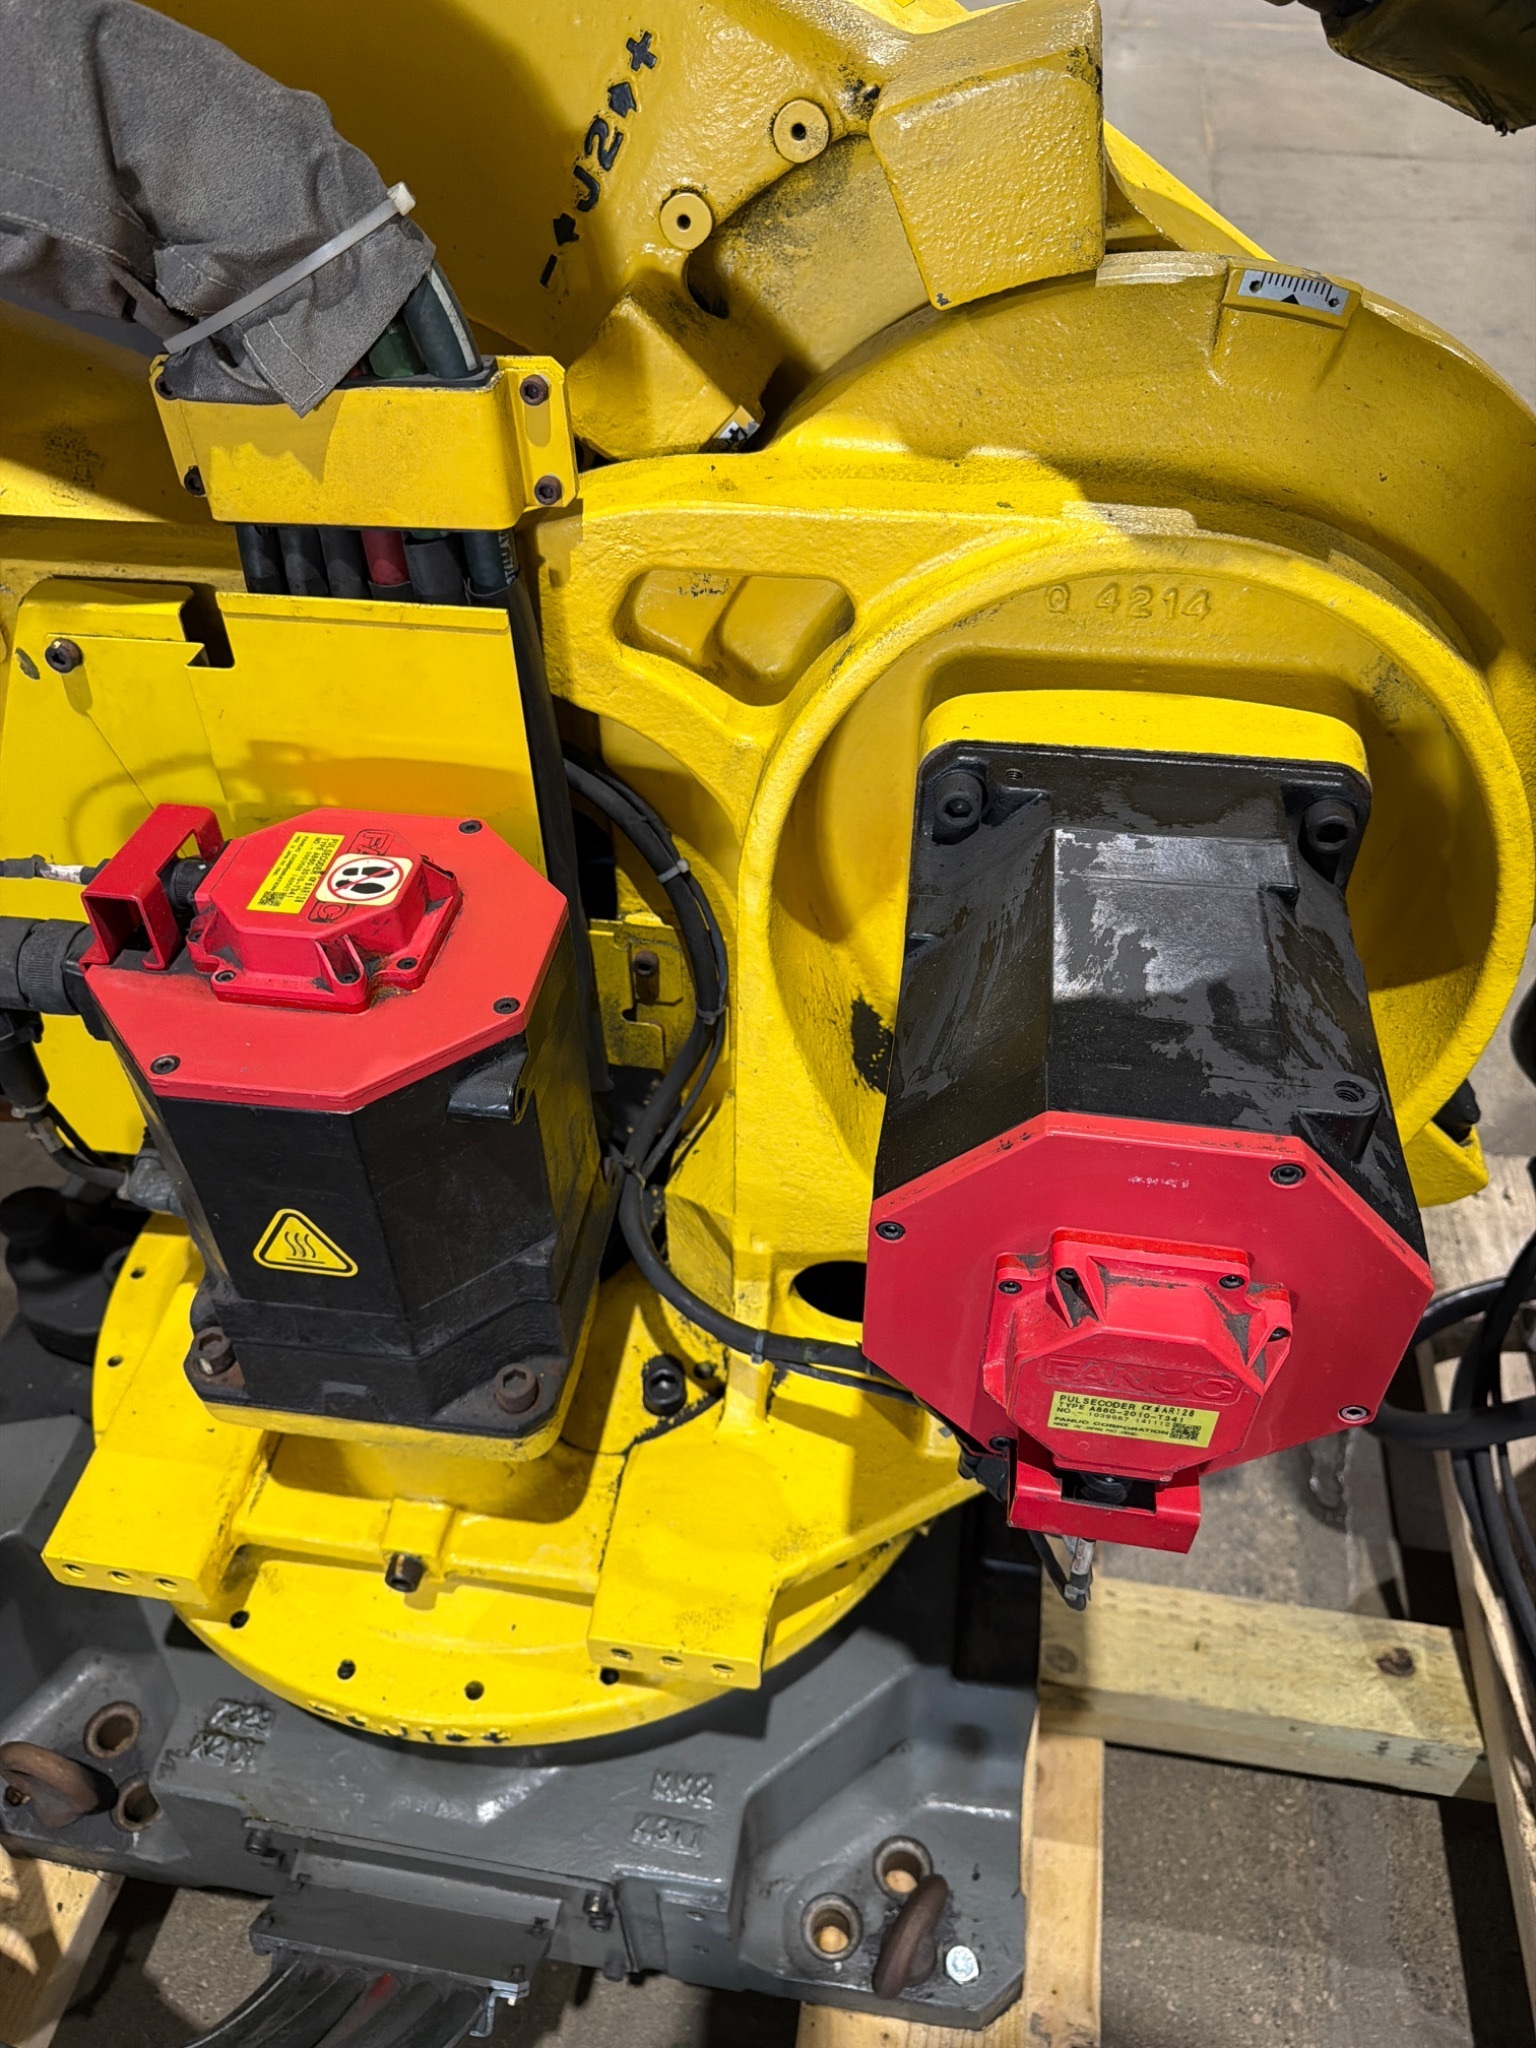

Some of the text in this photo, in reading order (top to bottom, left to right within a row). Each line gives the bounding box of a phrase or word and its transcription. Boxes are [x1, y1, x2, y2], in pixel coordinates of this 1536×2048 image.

[573, 117, 624, 212] J2
[1044, 581, 1212, 622] Q 4214
[1046, 1355, 1234, 1400] FANUC
[1059, 1402, 1184, 1423] TYPE A860-2010-T341
[1060, 1394, 1136, 1411] PULSECODER
[1054, 1416, 1169, 1436] FANUC CORPORATION
